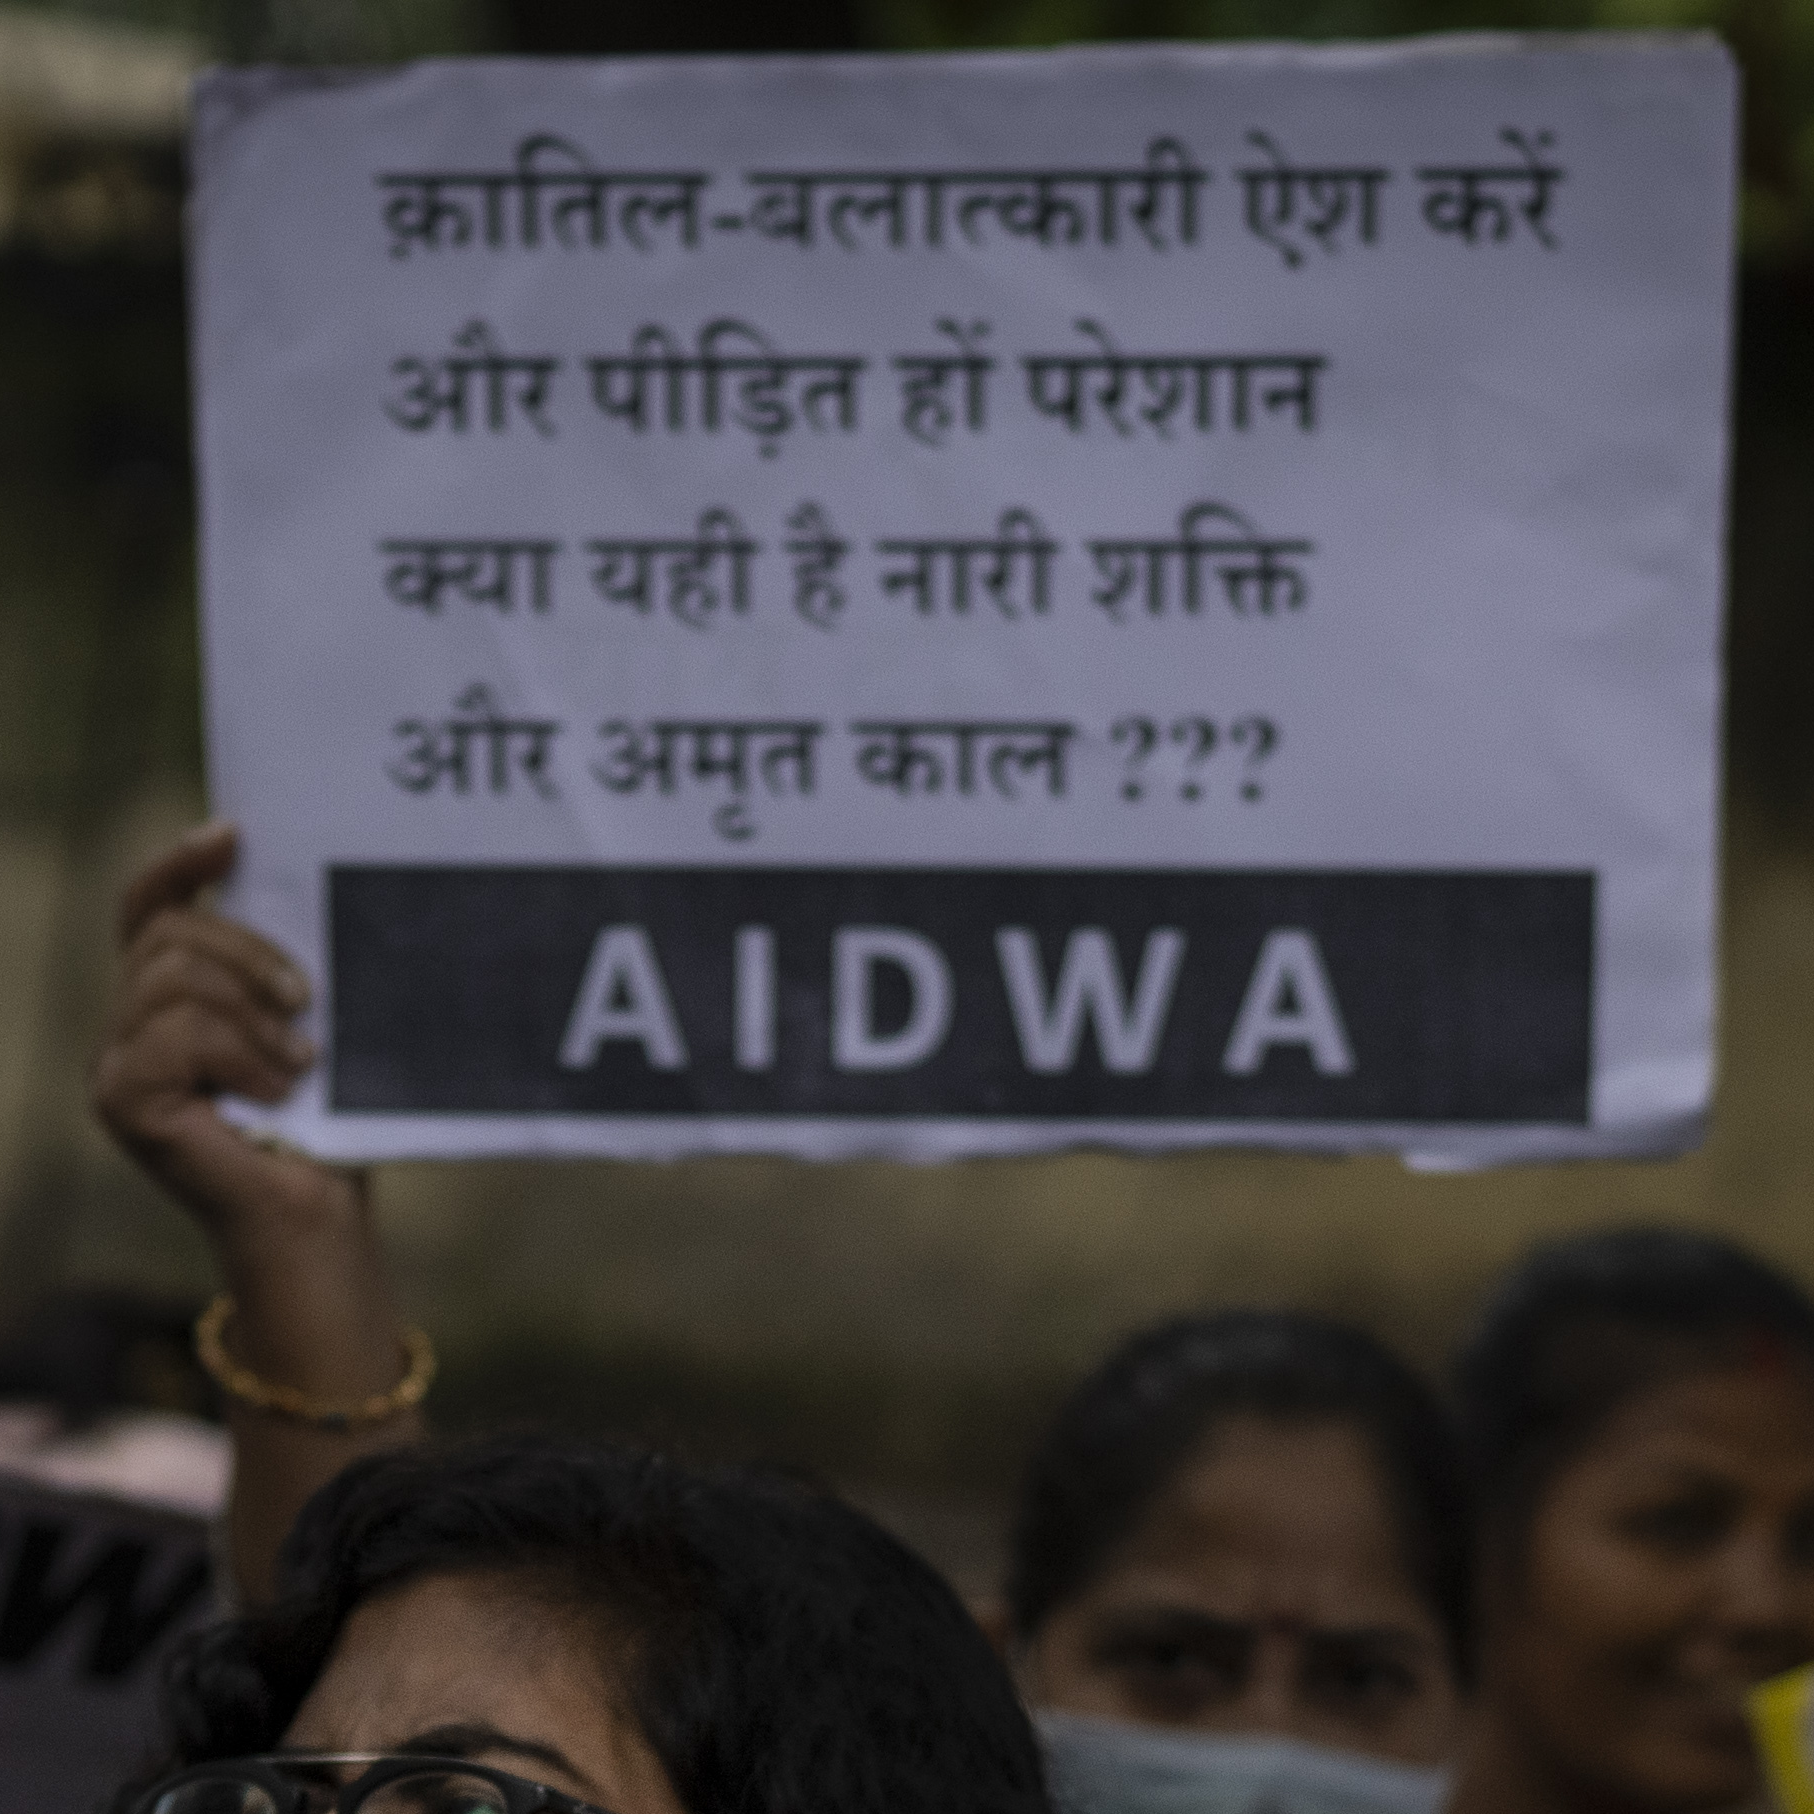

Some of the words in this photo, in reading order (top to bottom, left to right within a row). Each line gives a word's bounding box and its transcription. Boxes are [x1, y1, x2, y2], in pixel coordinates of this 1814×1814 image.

[1234, 129, 1387, 269] ऐश
[1418, 125, 1566, 252] करें
[387, 319, 560, 437] और
[587, 319, 866, 456] पीड़ित
[889, 316, 991, 446] हों
[1022, 319, 1327, 438] परेशान
[378, 535, 563, 622] क्या
[587, 506, 758, 631] यही
[787, 504, 847, 631] है
[874, 506, 1056, 621] नारी
[1087, 500, 1312, 625] शक्ति
[387, 681, 558, 803] और
[594, 716, 824, 840] अमृत
[849, 716, 1075, 803] काल
[1112, 715, 1278, 803] ???
[559, 925, 1354, 1075] AIDWA
